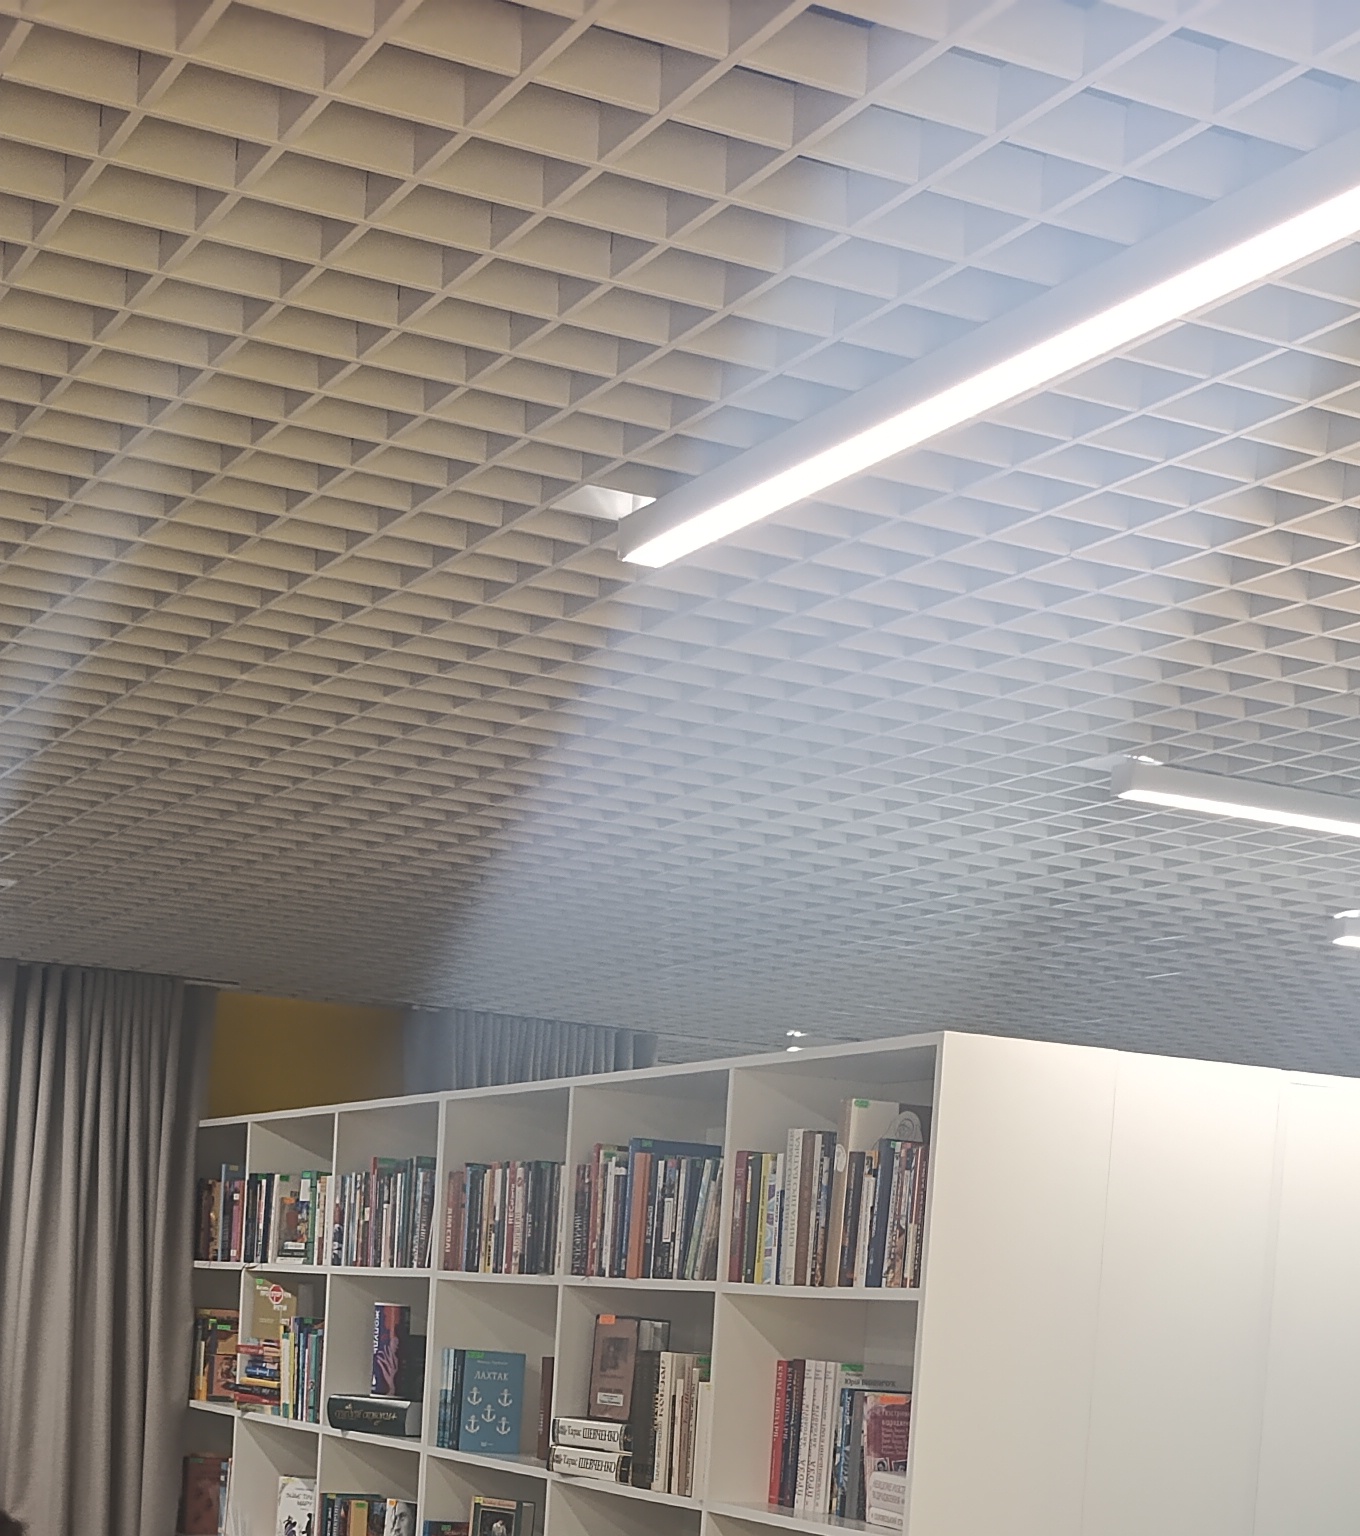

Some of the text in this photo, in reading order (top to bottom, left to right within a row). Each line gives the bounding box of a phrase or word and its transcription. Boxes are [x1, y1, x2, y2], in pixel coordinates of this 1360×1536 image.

[474, 1370, 509, 1381] ЛАХТАК
[582, 1428, 619, 1443] ШЕВЧЕНКО
[578, 1457, 616, 1473] ШЕВЧЕНКО
